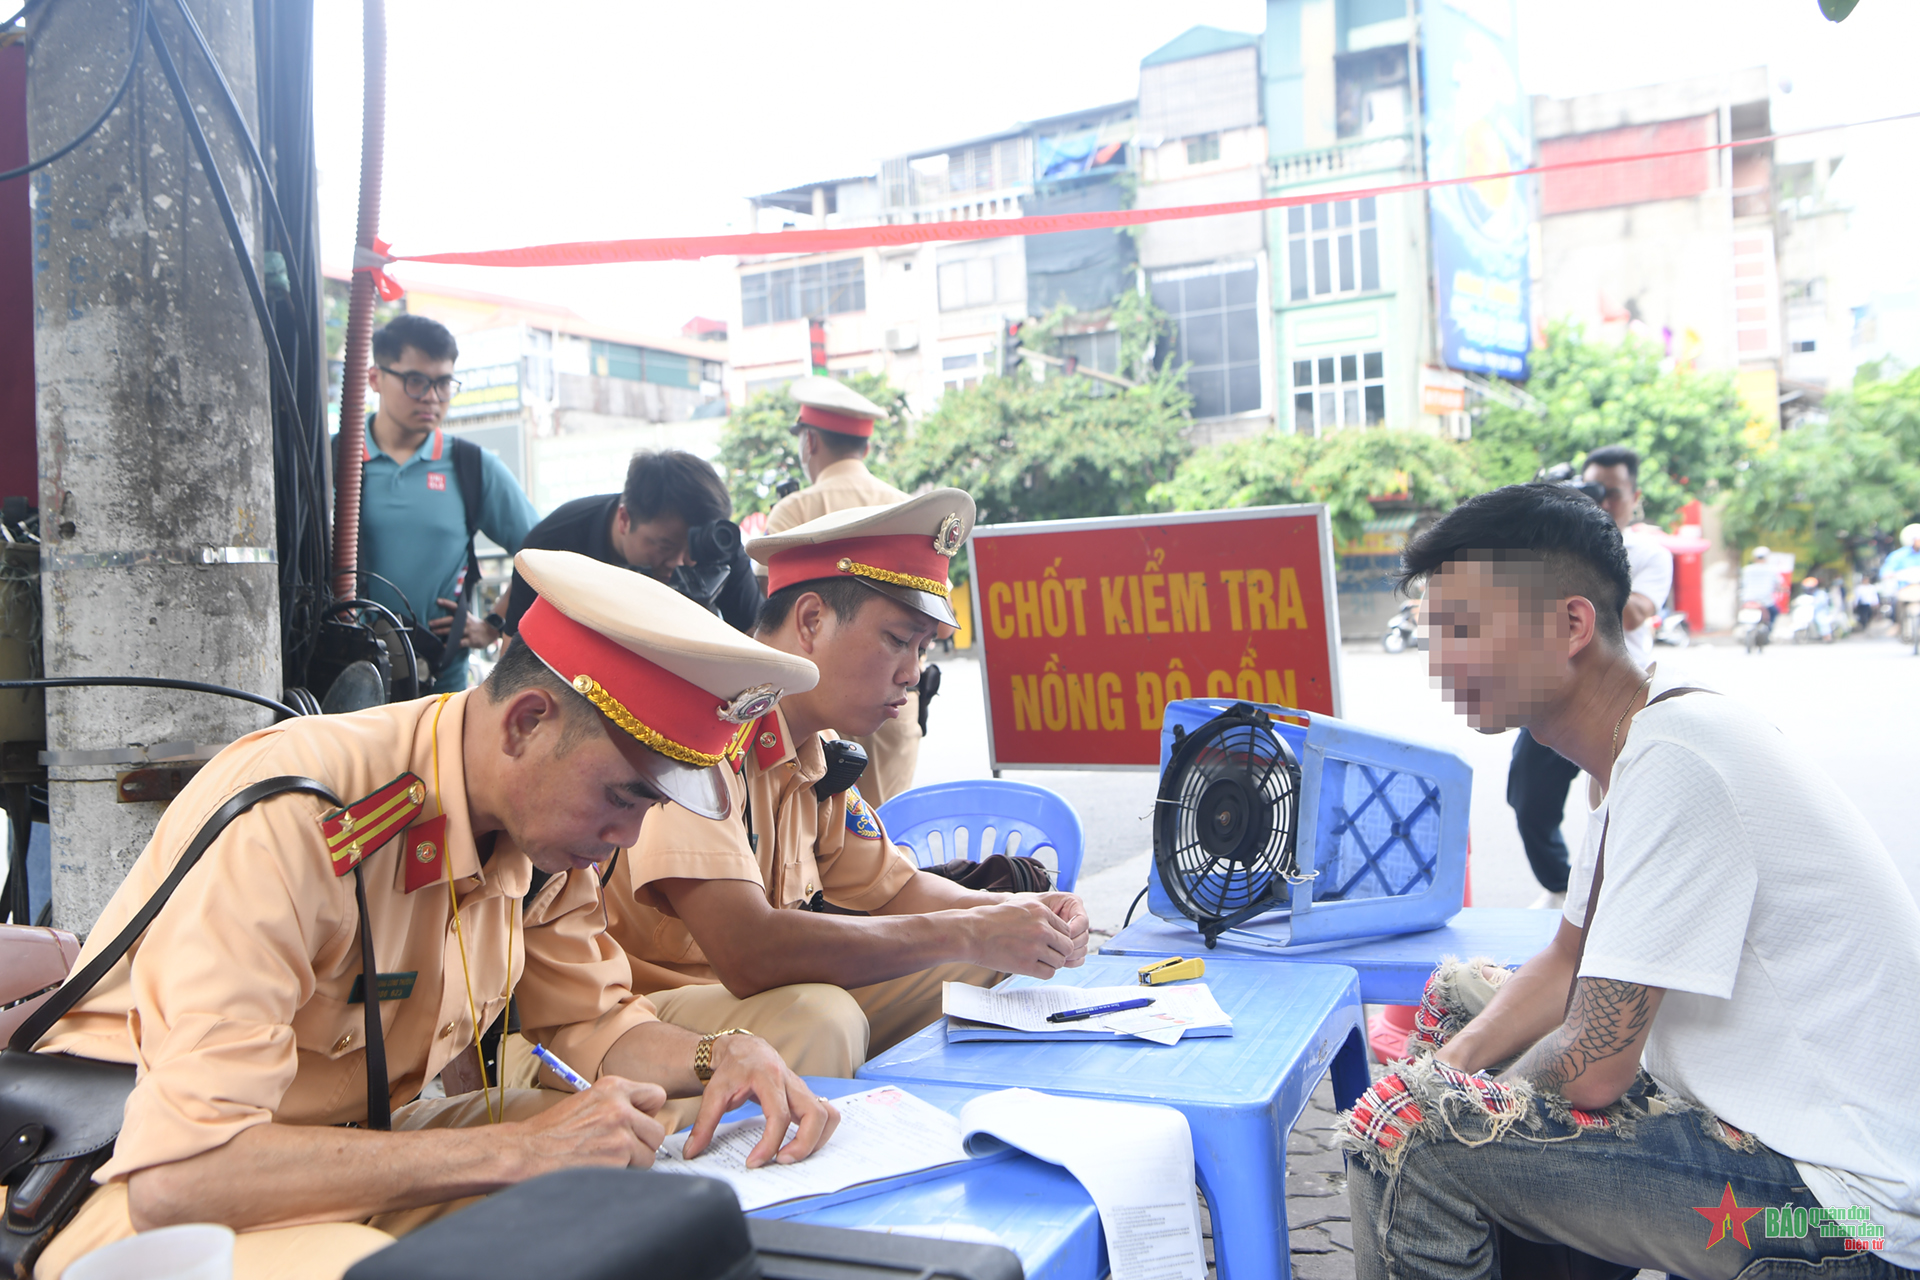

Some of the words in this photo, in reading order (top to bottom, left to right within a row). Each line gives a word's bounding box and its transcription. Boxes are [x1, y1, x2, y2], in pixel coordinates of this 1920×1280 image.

[988, 557, 1087, 640] CHỐT
[1100, 547, 1211, 635] KIỂM
[1220, 567, 1308, 631] TRA
[1011, 653, 1126, 732] NỒNG
